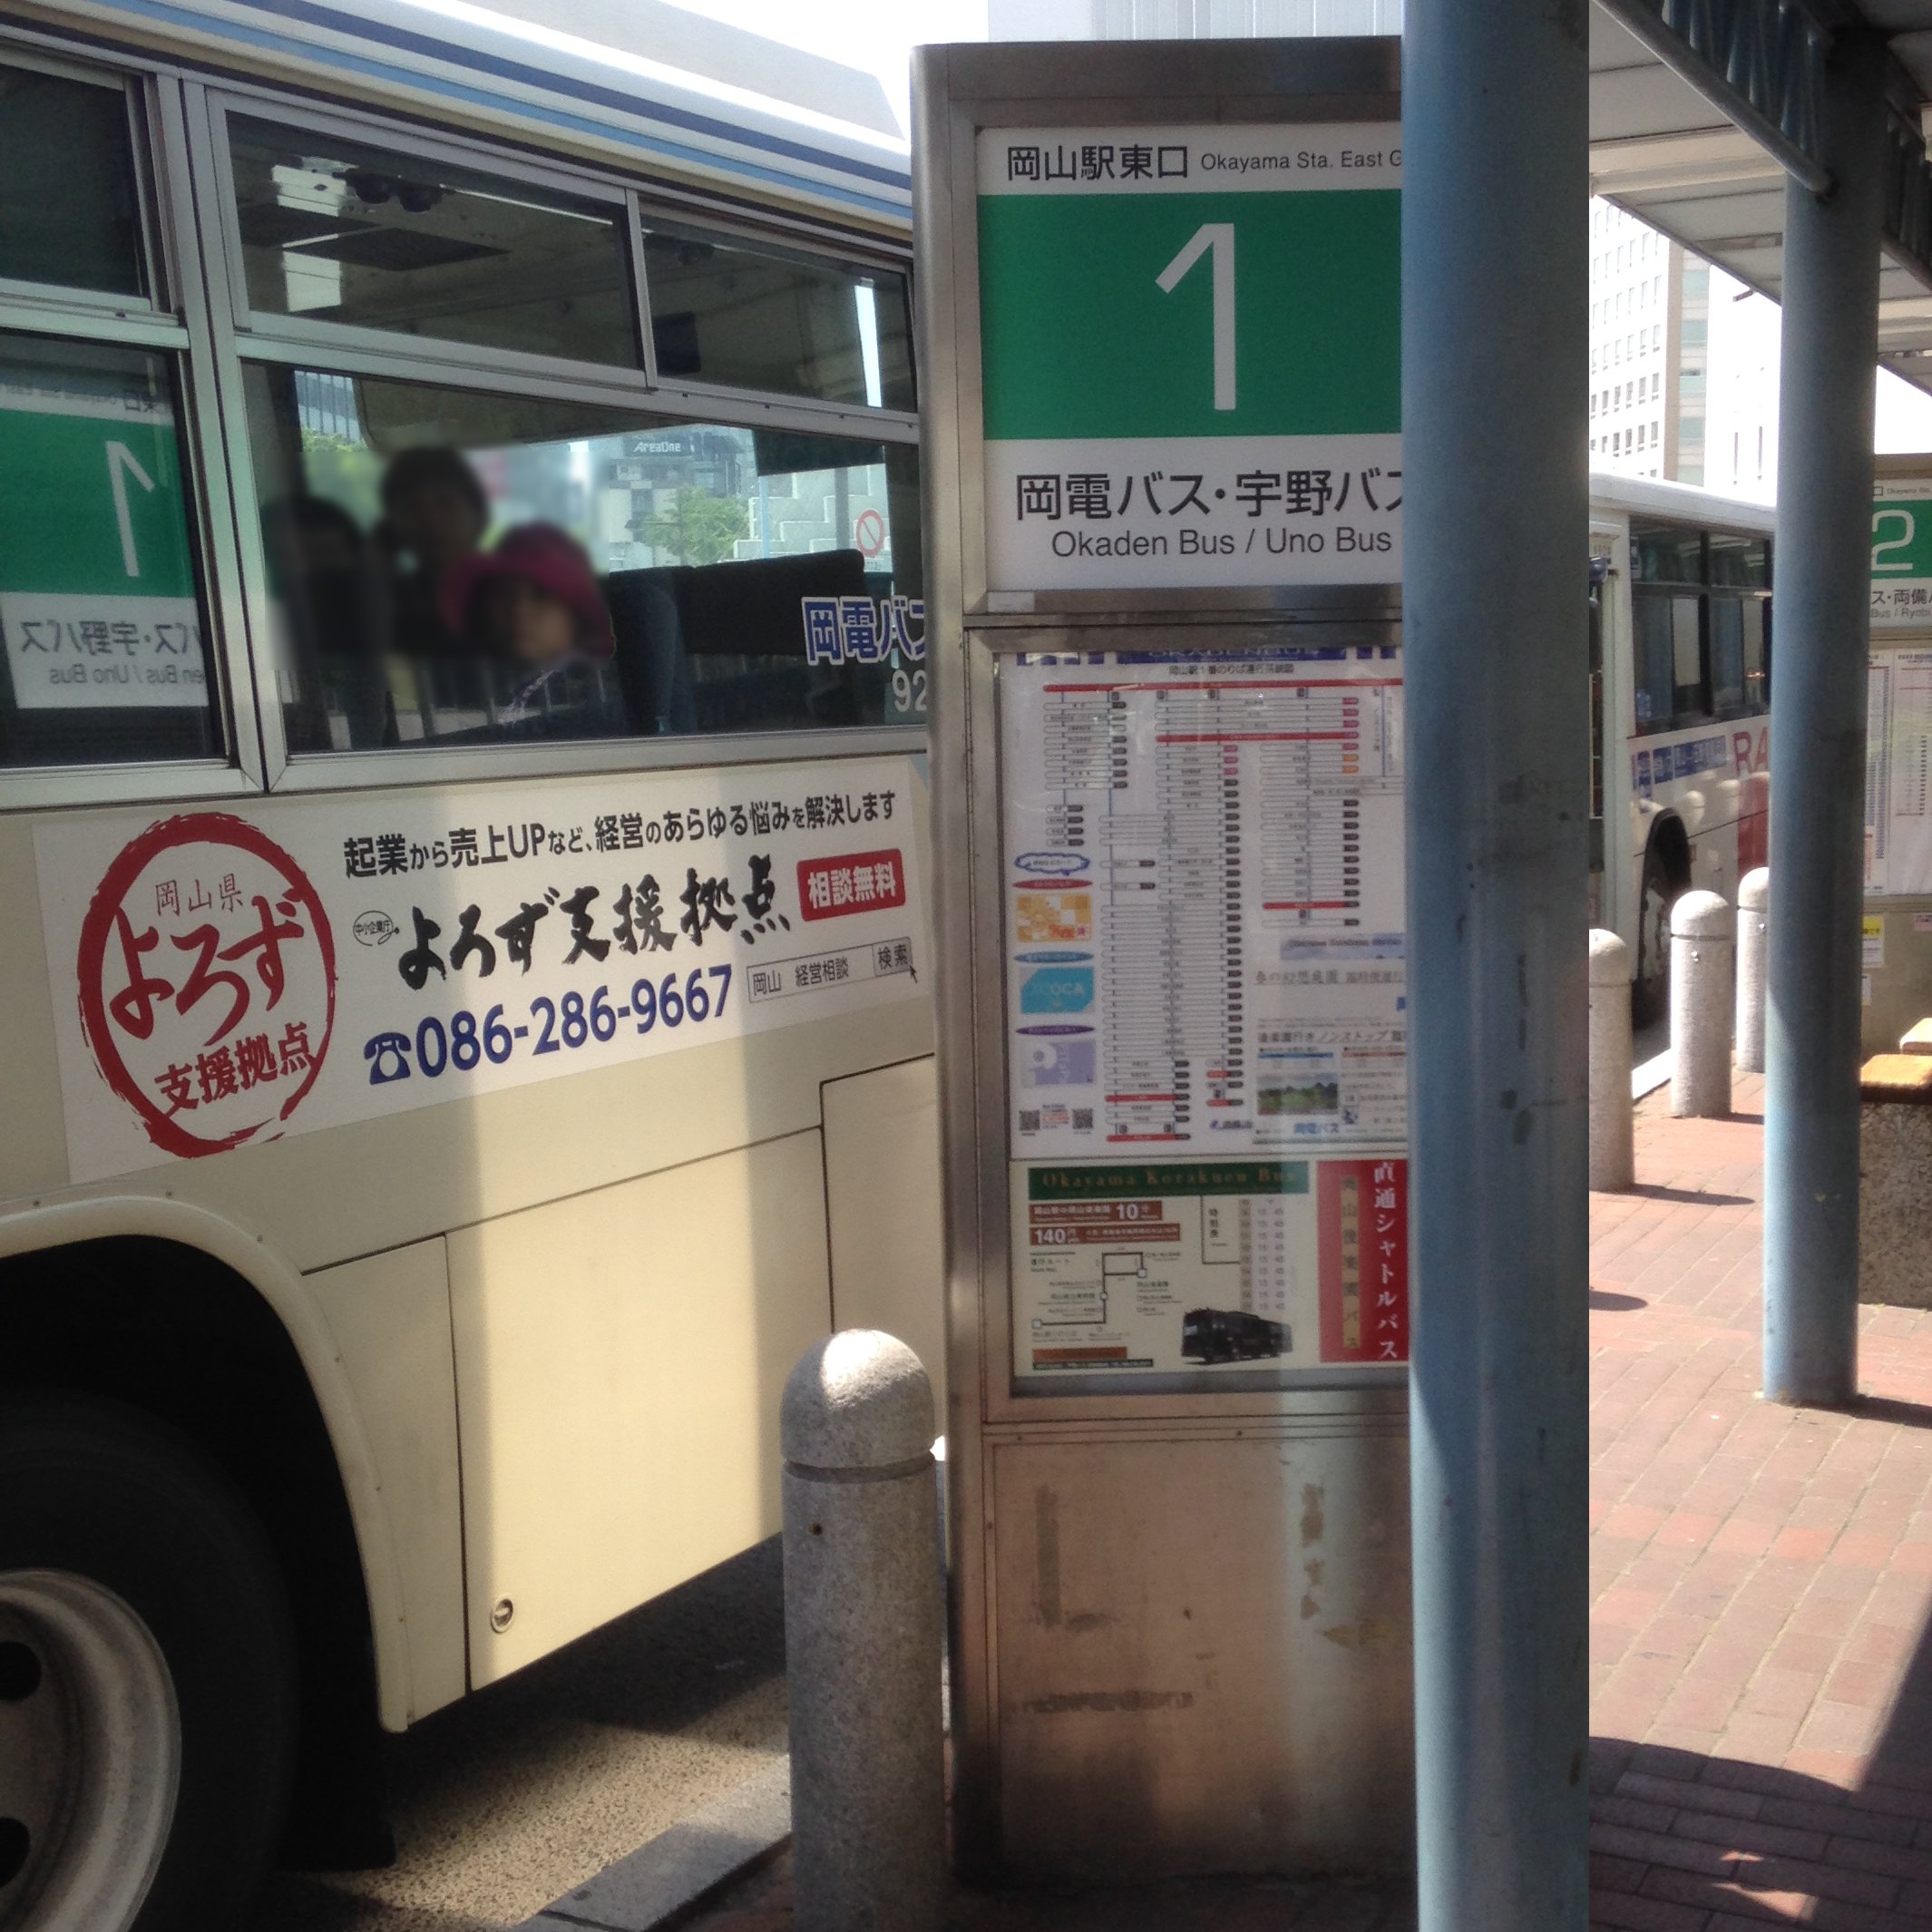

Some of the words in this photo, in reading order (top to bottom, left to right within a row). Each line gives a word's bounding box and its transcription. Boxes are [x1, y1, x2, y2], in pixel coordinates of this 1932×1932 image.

[1007, 144, 1188, 181] 岡山駅東口
[1201, 151, 1290, 176] Okayama
[1297, 151, 1333, 170] Sta.
[1341, 149, 1383, 169] East
[1156, 222, 1236, 411] 1
[1052, 528, 1168, 557] Okaden
[1180, 528, 1234, 555] Bus
[1266, 527, 1325, 554] Uno
[1336, 526, 1392, 552] Bus
[1871, 509, 1915, 571] 2
[344, 789, 896, 878] 起業から売上UPなど、経営のあらゆる悩みを解決します
[154, 873, 243, 917] 岡山県
[399, 854, 791, 991] よろず支援拠点
[807, 861, 896, 909] 相談無料
[109, 891, 305, 1047] よろず
[753, 970, 782, 996] 岡山
[795, 957, 849, 988] 経営相談
[877, 943, 908, 971] 検索
[415, 964, 732, 1078] 086-286-9667
[154, 1021, 315, 1117] 支援拠点
[1373, 1161, 1399, 1359] 直通シャトルバス
